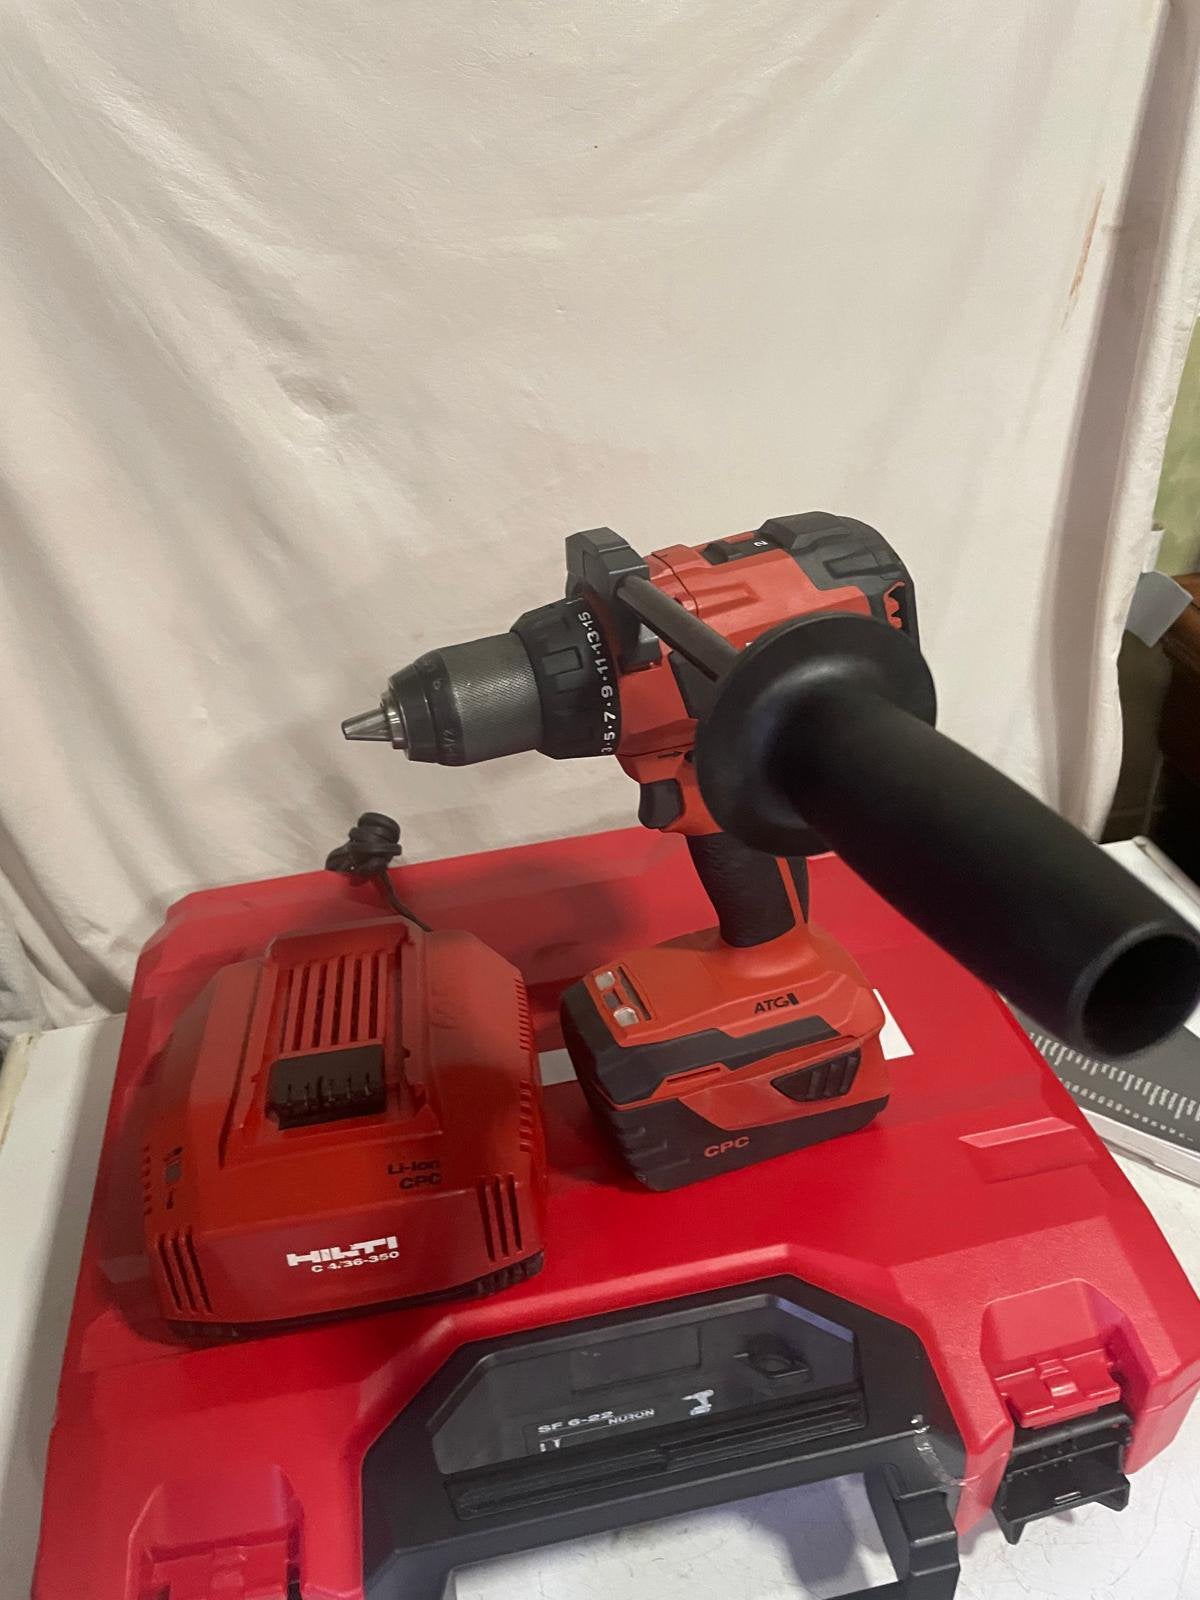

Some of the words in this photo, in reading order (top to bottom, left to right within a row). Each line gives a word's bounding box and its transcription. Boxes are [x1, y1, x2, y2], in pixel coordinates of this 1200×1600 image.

[577, 611, 594, 628] 15
[586, 630, 603, 651] 13
[594, 657, 609, 675] 11
[600, 685, 614, 699] 9
[603, 711, 617, 723] 7
[603, 731, 616, 742] 5
[703, 1136, 751, 1158] CPC
[387, 1160, 441, 1176] Li-Ion
[400, 1174, 443, 1191] CPC
[286, 1236, 399, 1267] HILTI
[311, 1265, 324, 1273] C
[537, 1421, 563, 1434] SF
[567, 1411, 613, 1426] 6-22
[607, 1408, 655, 1426] NURON
